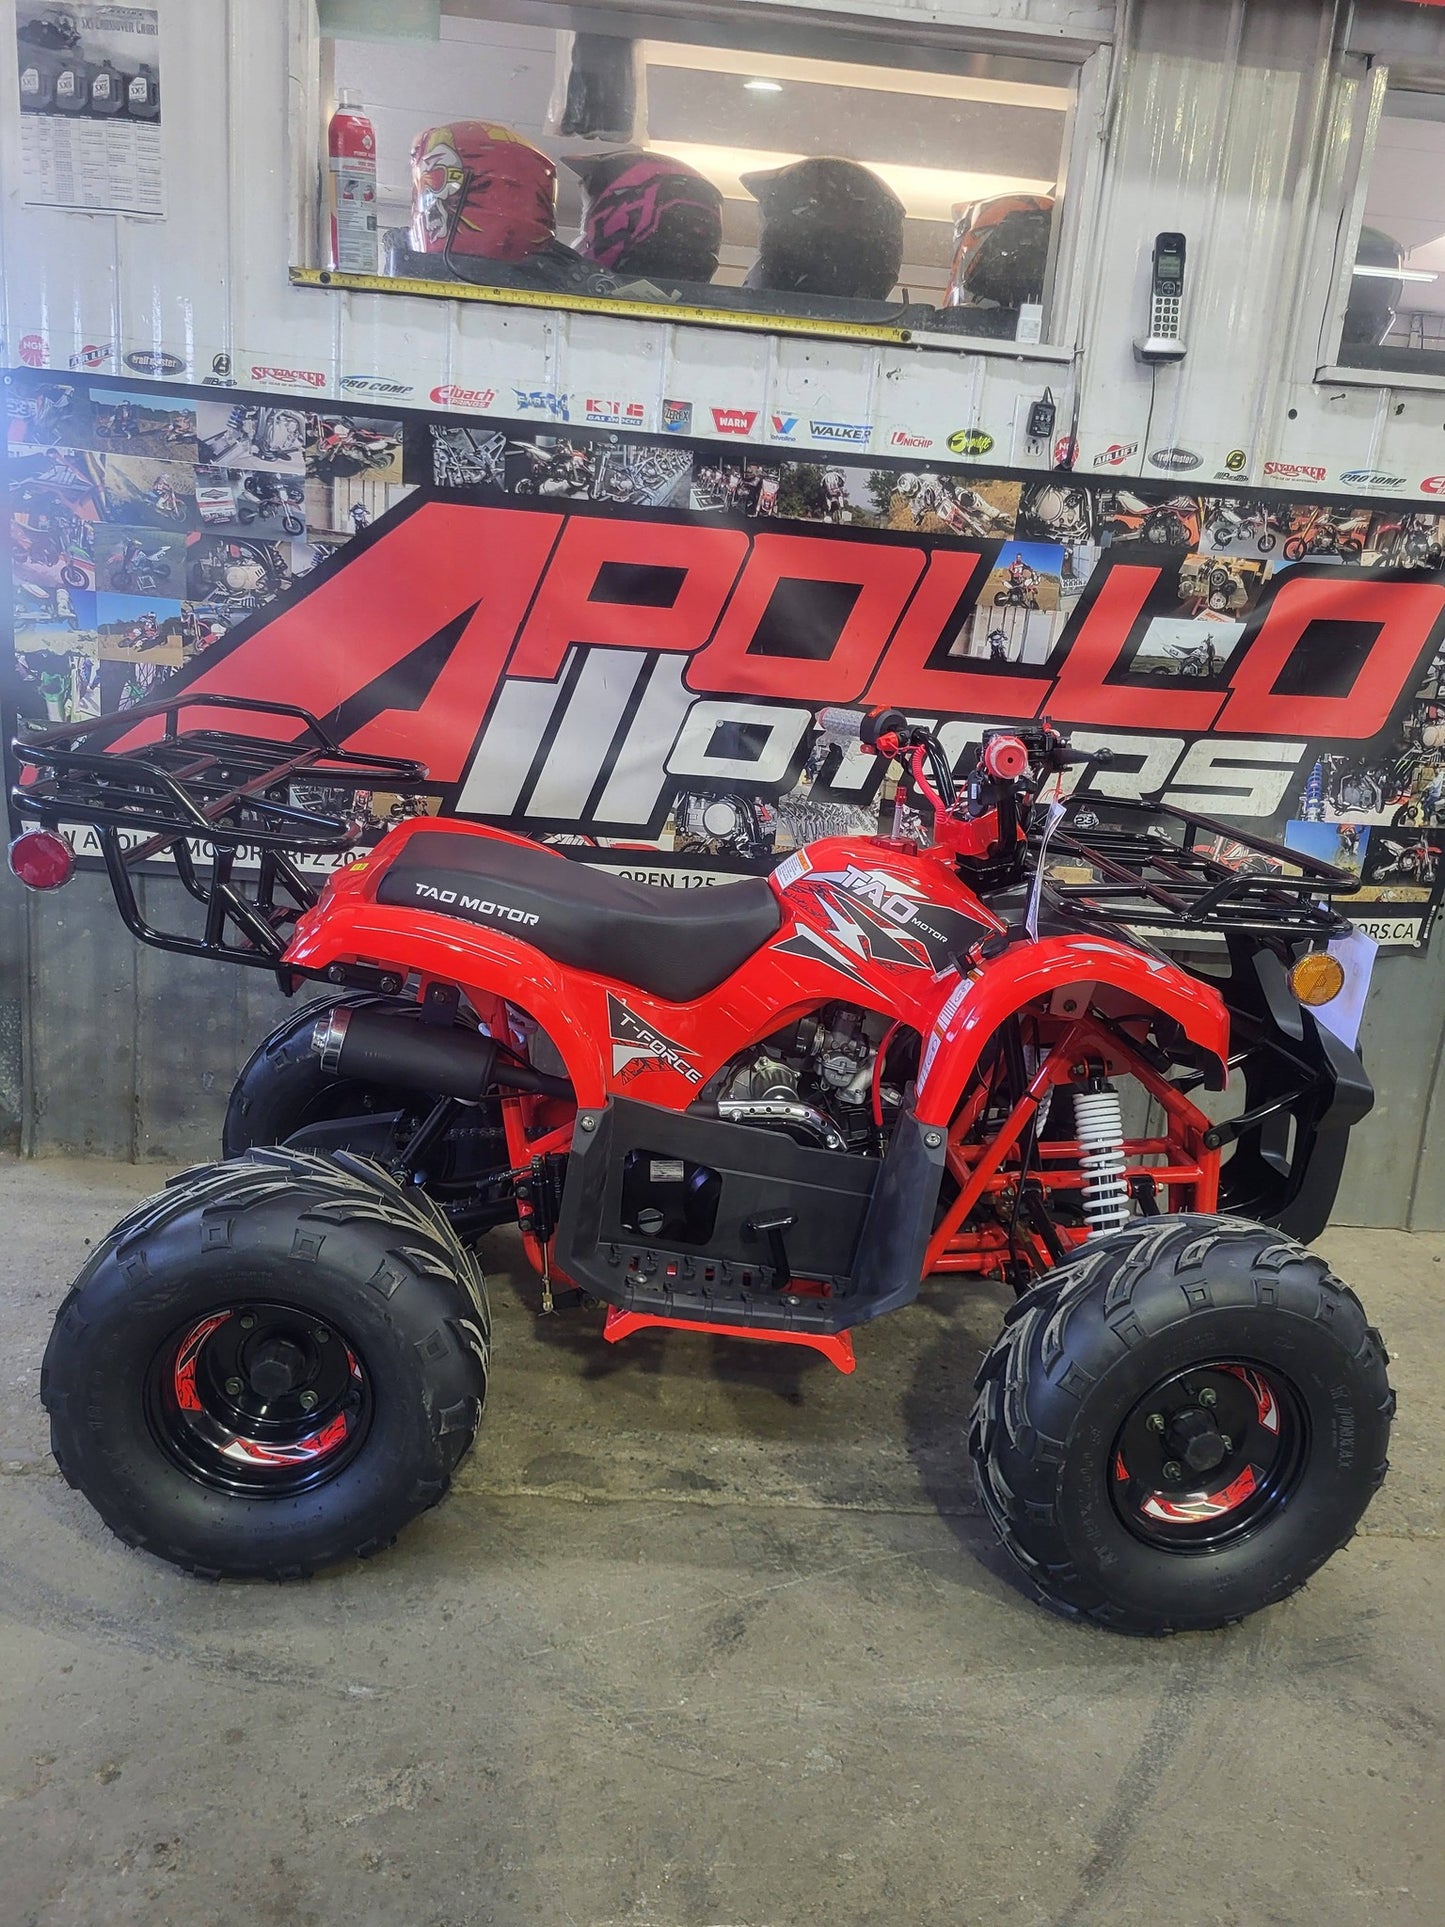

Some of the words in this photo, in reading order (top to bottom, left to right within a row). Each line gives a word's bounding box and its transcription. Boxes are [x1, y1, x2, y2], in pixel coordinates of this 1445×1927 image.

[251, 366, 326, 387] SKYJACKER
[340, 378, 368, 389] PRO
[369, 381, 415, 395] COMP
[719, 417, 747, 429] WARN
[809, 420, 871, 441] WALKER
[891, 431, 933, 448] UNICHIP
[1094, 452, 1113, 465] AIR
[1114, 445, 1138, 460] LIFT
[1264, 462, 1326, 481] SKYJACKER
[1340, 473, 1369, 483] PRO
[103, 501, 1445, 783] APOLLO
[416, 882, 457, 904] TAO
[459, 895, 540, 926] MOTOR
[841, 863, 920, 925] TAO
[911, 917, 949, 944] MOTOR
[620, 1012, 704, 1085] T-FORCE
